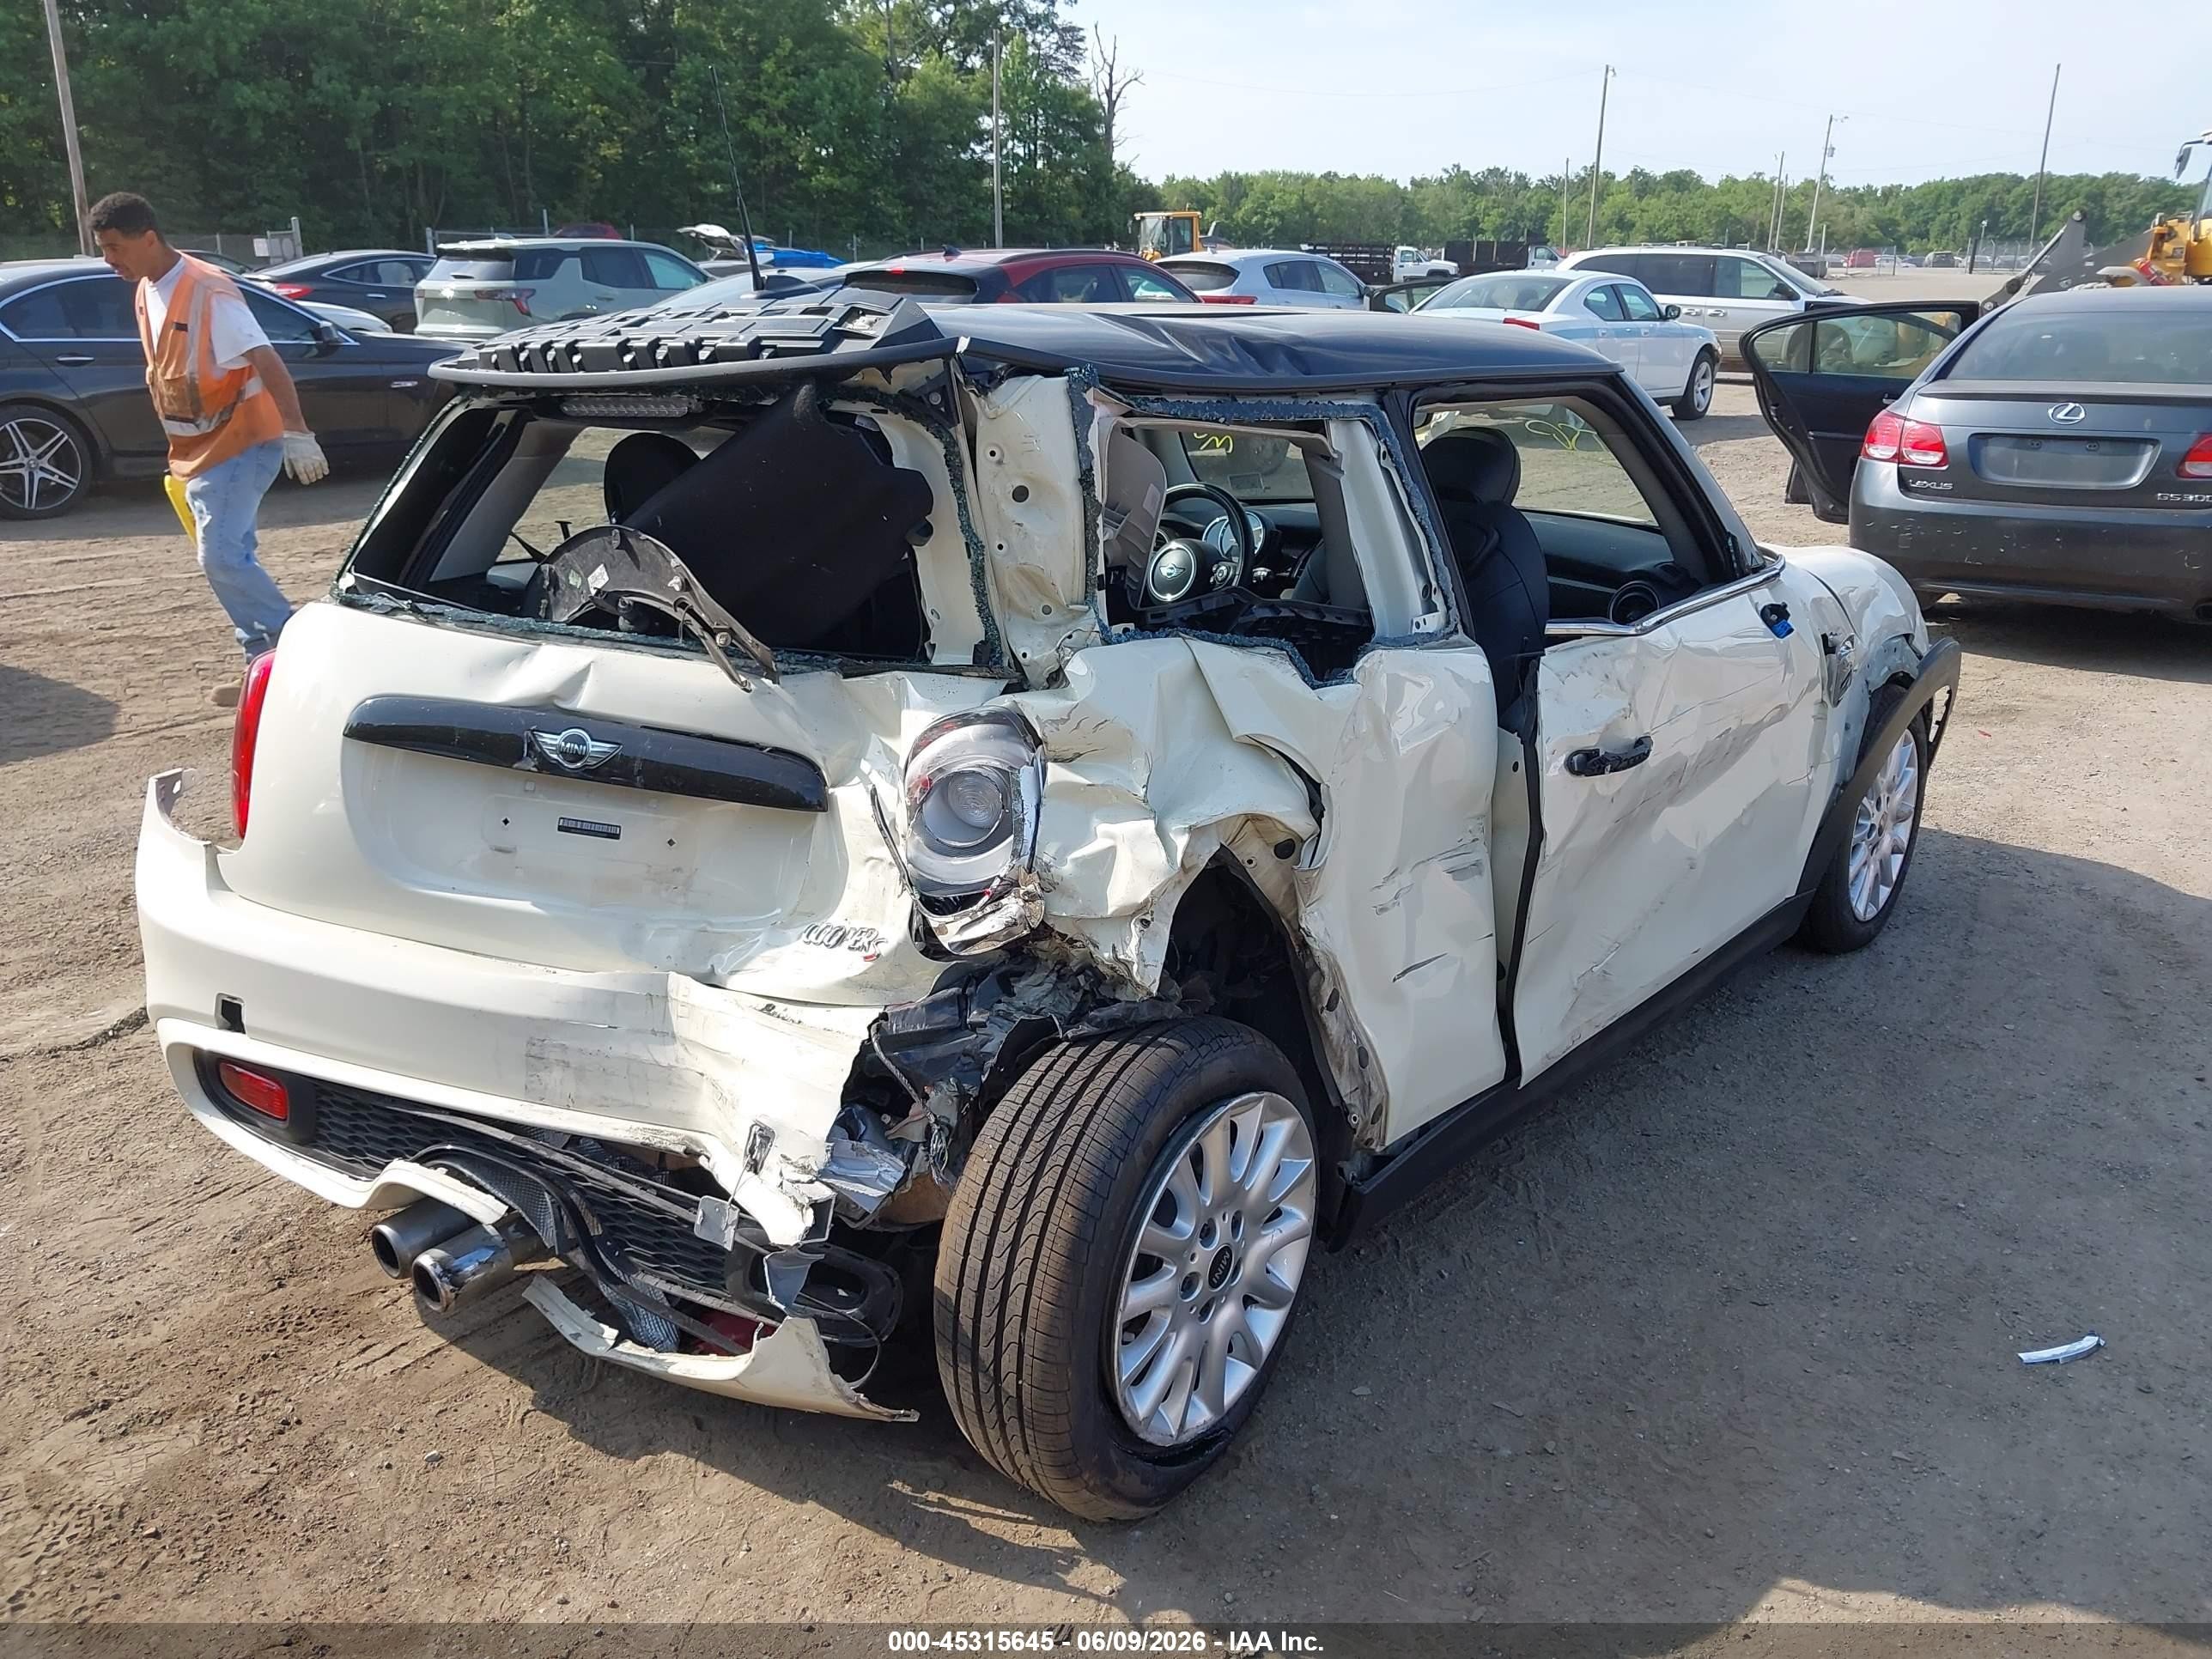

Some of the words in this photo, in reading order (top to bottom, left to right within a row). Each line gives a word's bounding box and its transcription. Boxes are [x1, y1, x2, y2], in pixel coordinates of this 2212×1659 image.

[1909, 479, 1954, 490] LEXUS
[560, 741, 586, 757] MINI
[1212, 1250, 1231, 1284] MINI
